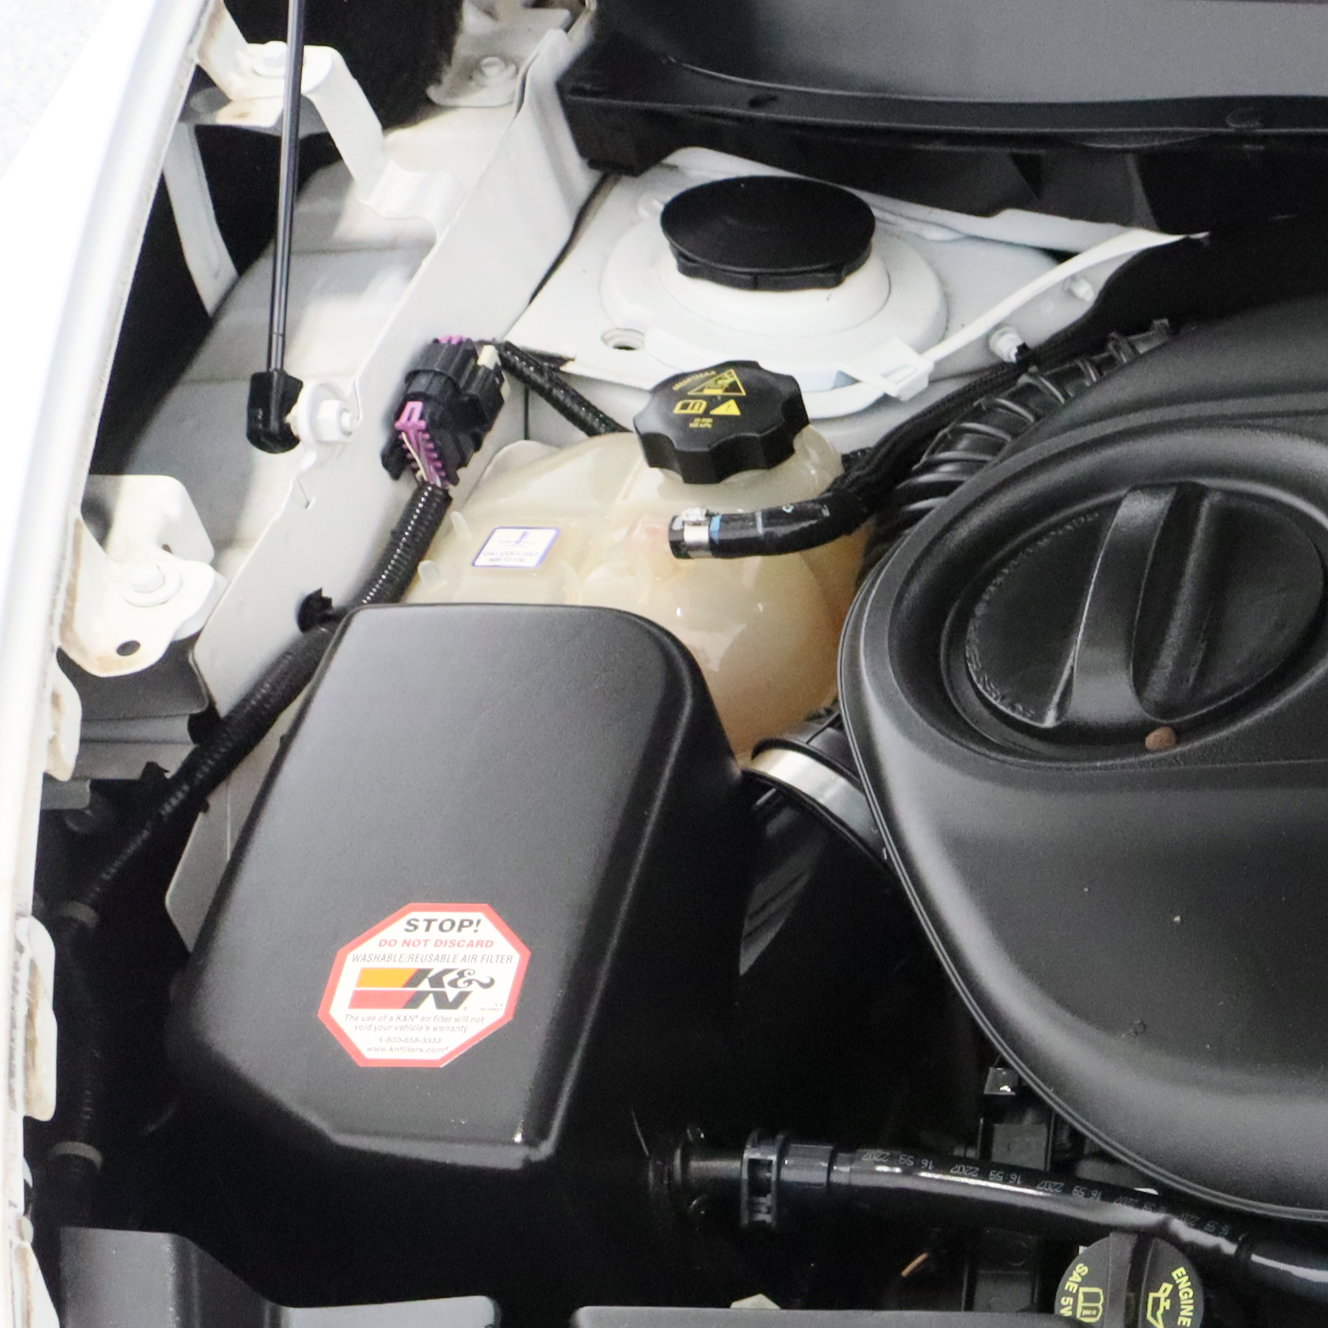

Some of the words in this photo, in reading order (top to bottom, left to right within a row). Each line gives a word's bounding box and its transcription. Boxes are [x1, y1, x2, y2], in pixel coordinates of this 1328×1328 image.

[404, 918, 481, 933] STOP!
[378, 939, 397, 948] DO
[401, 939, 430, 948] NOT
[435, 940, 494, 949] DISCARD
[460, 954, 477, 963] AIR
[480, 954, 513, 964] FILTER
[345, 1014, 360, 1022] The
[374, 1024, 392, 1033] your
[1064, 1263, 1089, 1293] SAE
[1171, 1266, 1194, 1328] ENGINE
